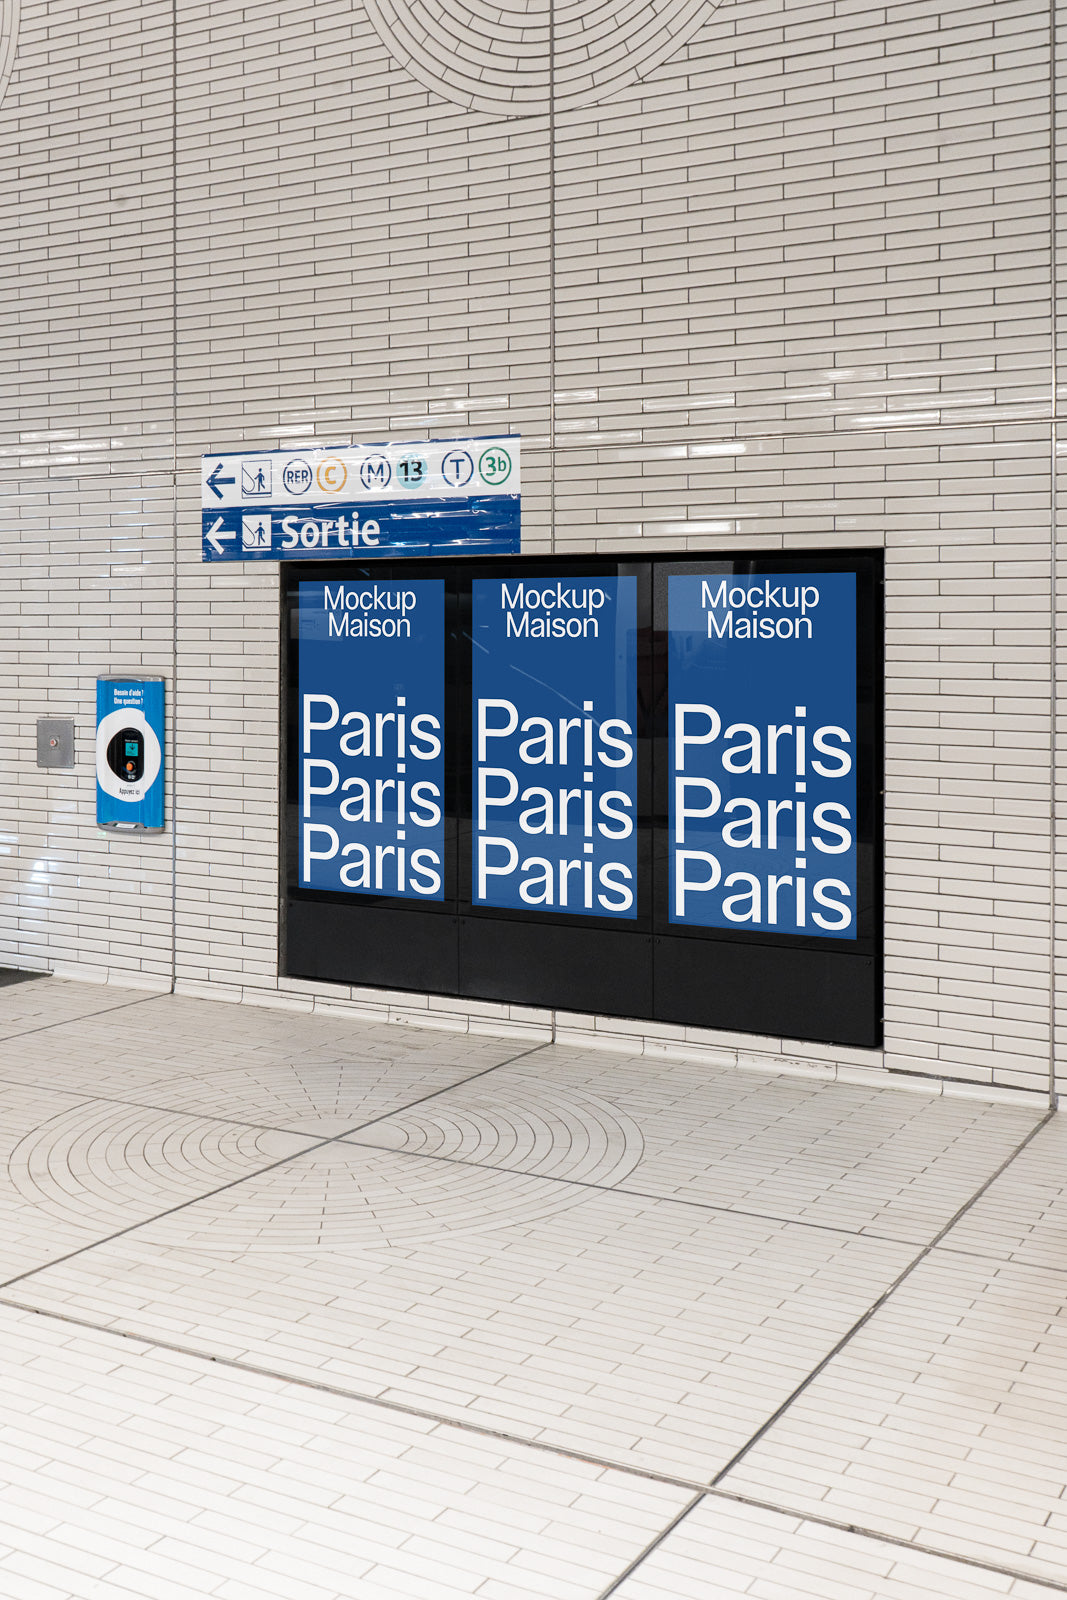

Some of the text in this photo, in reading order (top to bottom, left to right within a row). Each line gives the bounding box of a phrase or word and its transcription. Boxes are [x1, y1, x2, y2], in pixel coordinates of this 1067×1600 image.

[287, 457, 507, 485] RER C M 13 T 3b
[281, 511, 381, 548] Sortie
[325, 585, 417, 616] Mockup
[329, 612, 411, 637] Maison
[502, 583, 605, 615] Mockup
[507, 611, 599, 638] Maison
[702, 580, 820, 615] Mockup
[708, 611, 813, 639] Maison
[304, 694, 442, 760] Paris
[478, 699, 634, 768] Paris
[675, 704, 852, 778] Paris
[304, 759, 442, 827] Paris
[478, 767, 634, 840] Paris
[676, 777, 852, 855] Paris
[304, 823, 442, 895] Paris
[478, 836, 634, 912] Paris
[676, 850, 852, 931] Paris
